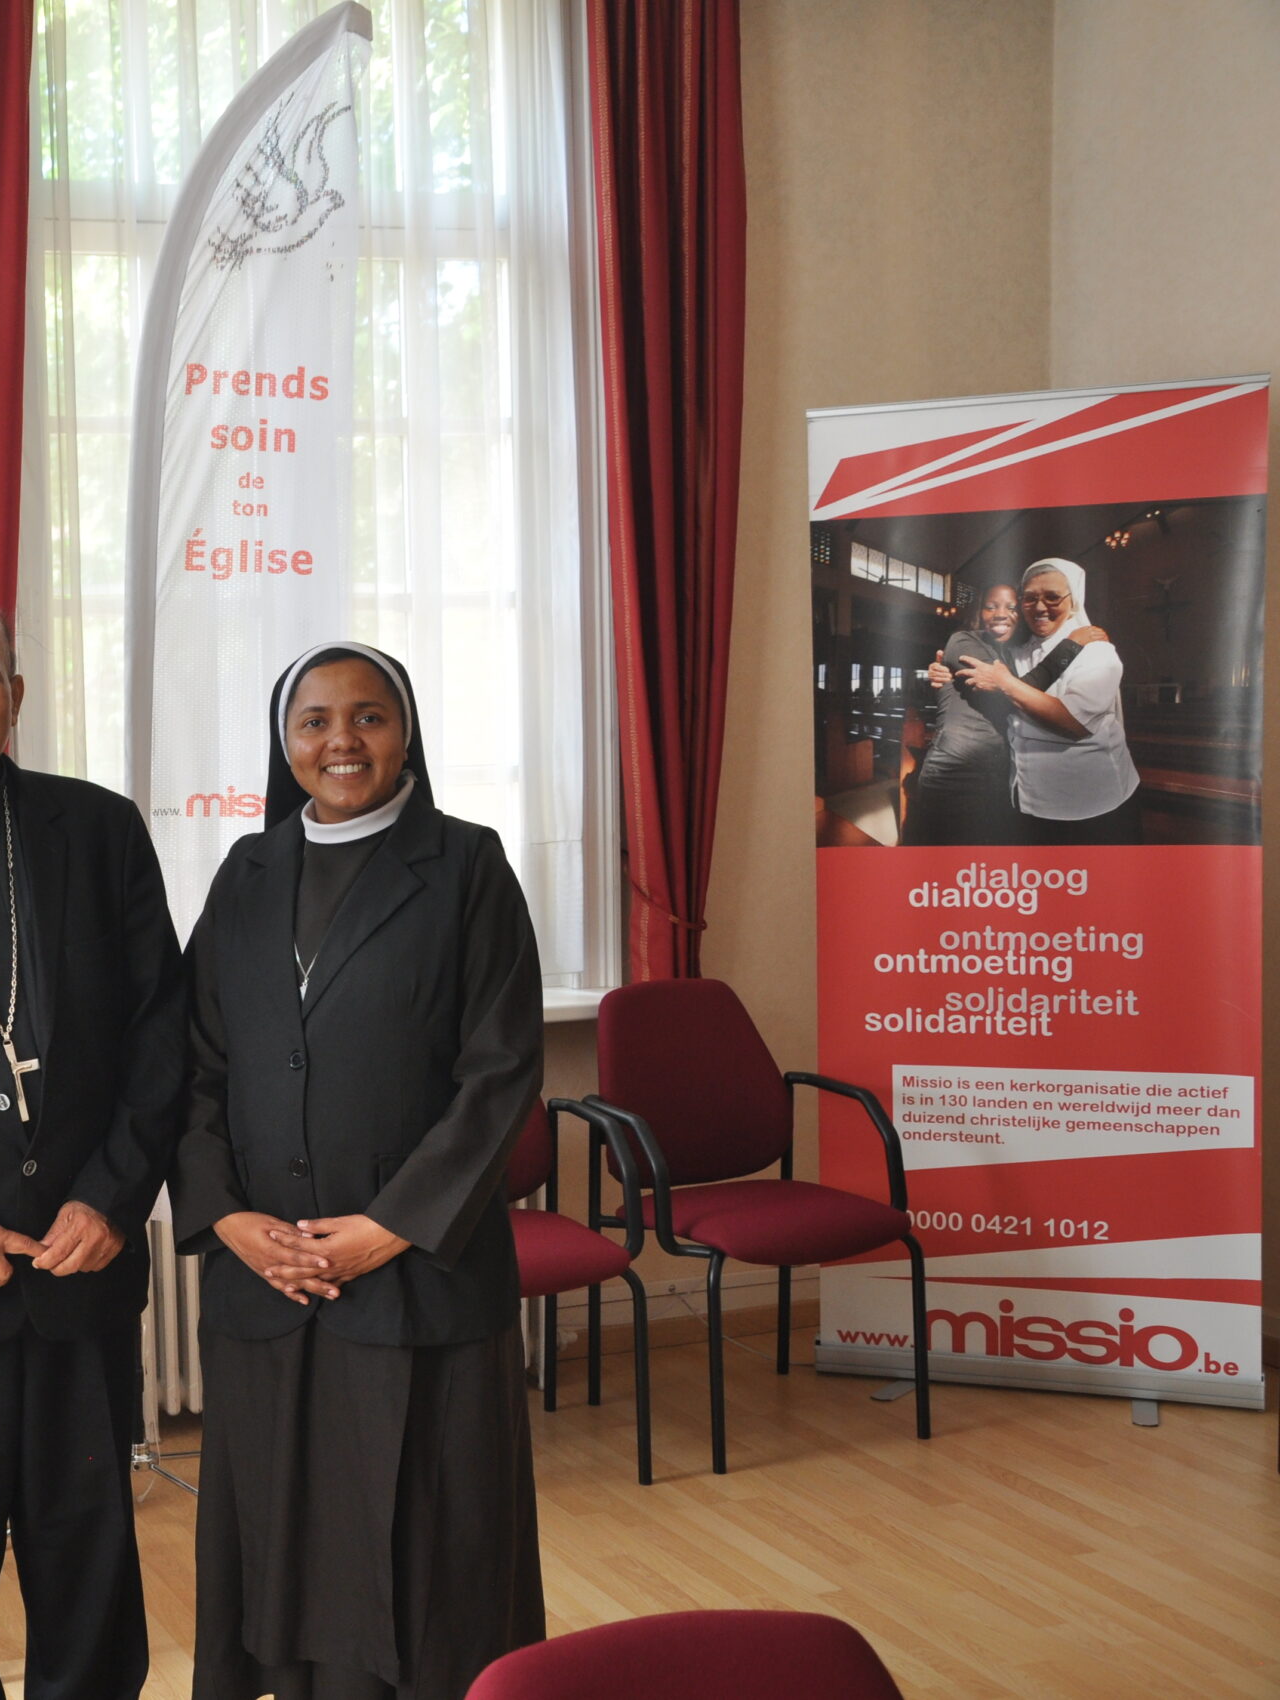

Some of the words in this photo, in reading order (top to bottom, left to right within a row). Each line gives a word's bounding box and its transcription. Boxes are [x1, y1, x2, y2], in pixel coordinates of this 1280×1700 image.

[184, 363, 329, 401] Prends
[210, 418, 296, 453] soin
[238, 472, 265, 490] de
[232, 499, 269, 517] ton
[184, 527, 313, 580] Église
[956, 862, 1088, 896] dialoog
[908, 881, 1038, 915] dialoog
[939, 925, 1144, 960] ontmoeting
[873, 948, 1073, 983] ontmoeting
[945, 986, 1140, 1016] solidariteit
[864, 1007, 1053, 1037] solidariteit
[902, 1075, 952, 1089] Missio
[957, 1077, 970, 1090] is
[975, 1080, 1005, 1091] een
[1010, 1079, 1141, 1097] kerkorganisatie
[1145, 1084, 1172, 1097] die
[1177, 1085, 1229, 1100] actief
[902, 1093, 915, 1105] is
[920, 1093, 934, 1106] in
[939, 1094, 968, 1107] 130
[972, 1096, 1028, 1110] landen
[1032, 1100, 1053, 1111] en
[1058, 1100, 1151, 1117] wereldwijd
[1156, 1104, 1202, 1117] meer
[1207, 1105, 1241, 1119] dan
[902, 1111, 966, 1125] duizend
[970, 1113, 1061, 1132] christelijke
[1065, 1119, 1220, 1137] gemeenschappen
[902, 1129, 1005, 1145] ondersteunt.
[970, 1213, 1032, 1236] 0421
[1044, 1217, 1109, 1241] 1012
